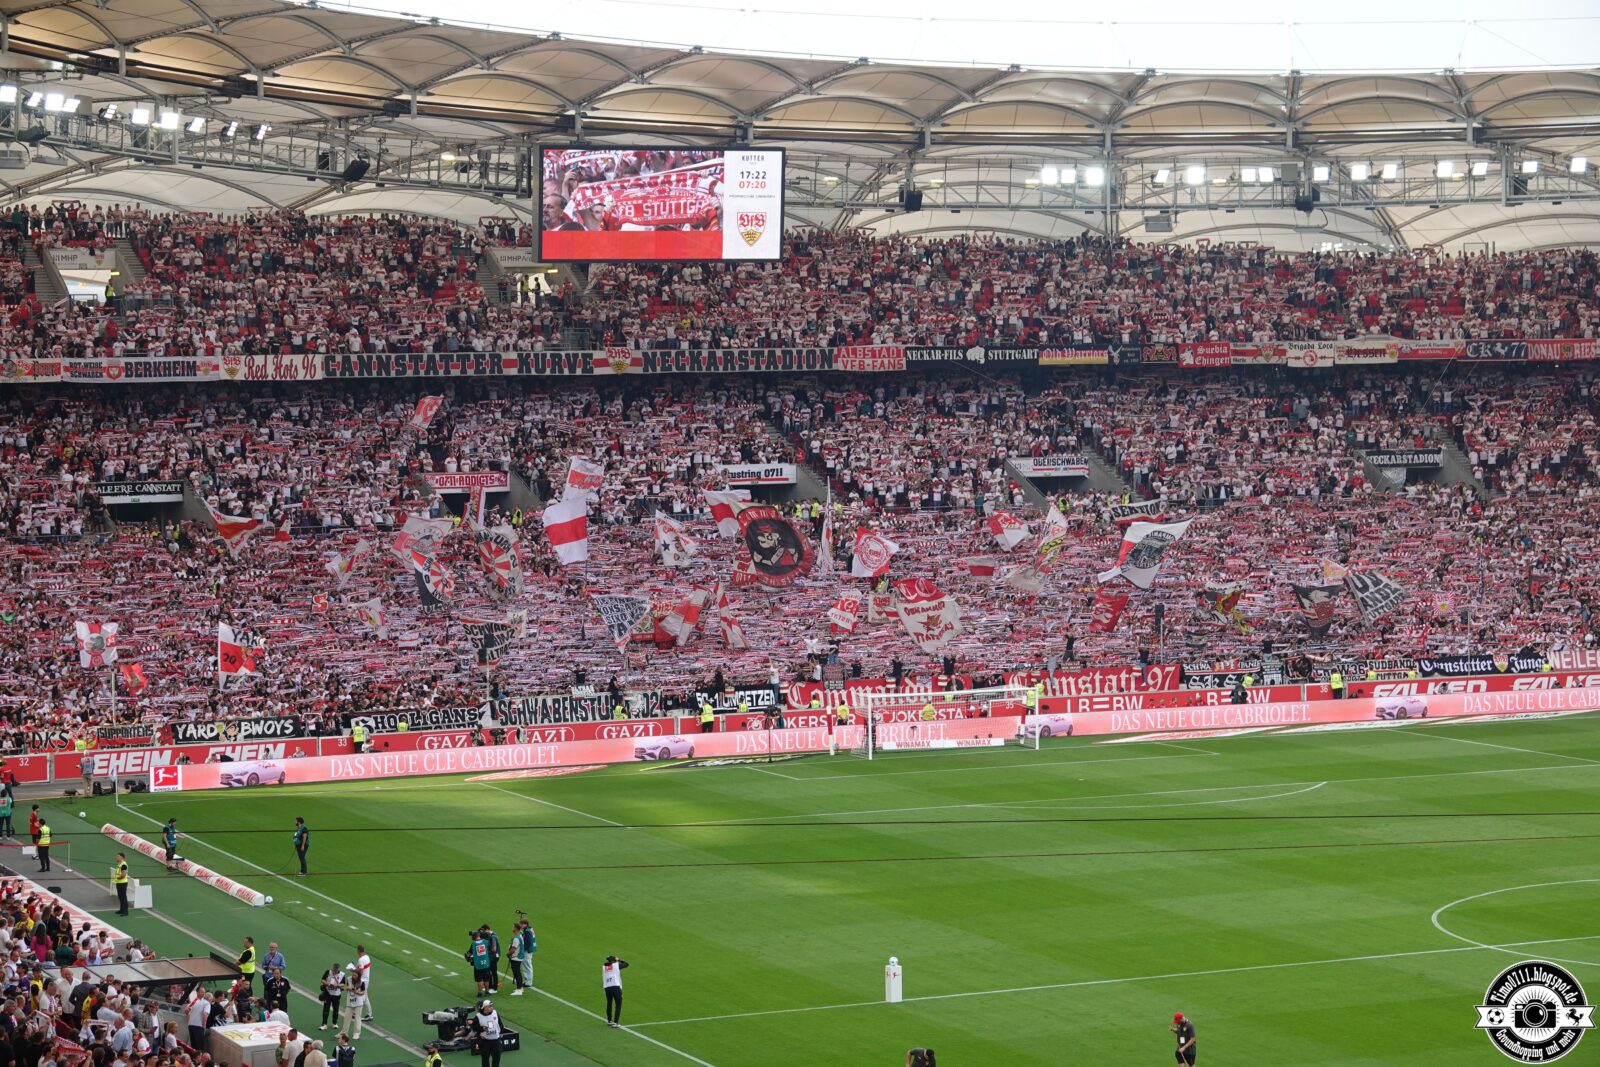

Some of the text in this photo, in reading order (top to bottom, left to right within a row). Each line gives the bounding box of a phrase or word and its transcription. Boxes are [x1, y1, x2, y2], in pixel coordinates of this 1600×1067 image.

[740, 171, 767, 179] 17:22
[739, 181, 766, 189] 07:20
[907, 348, 1039, 361] NECKAR-FILS STUTTGART
[1065, 347, 1109, 360] Warriors
[1528, 342, 1597, 360] DONAU RIES
[124, 361, 197, 378] BERKHEIM
[244, 355, 269, 380] Red
[302, 354, 317, 379] 96
[324, 352, 594, 376] CANNSTATTER KURVE
[642, 349, 835, 373] NECKARSTADION
[842, 358, 904, 371] VFB-FANS
[764, 467, 783, 477] 0711
[135, 483, 181, 493] CANNSTATT
[1147, 666, 1176, 691] 97
[1464, 696, 1491, 712] DAS
[1494, 693, 1535, 710] NEUE
[1538, 691, 1566, 708] CLE
[1112, 703, 1311, 731] DAS NEUE CLE CABRIOLET.
[177, 718, 295, 740] YARD BWOYS
[31, 730, 70, 750] DKS
[338, 738, 348, 747] 33
[736, 734, 768, 753] DAS
[772, 731, 817, 750] NEUE
[896, 740, 931, 748] WINAMAX
[956, 738, 992, 747] WINAMAX
[19, 757, 30, 767] 32
[93, 749, 173, 776] EHEIM
[331, 745, 561, 778] DAS NEUE CLE CABRIOLET.
